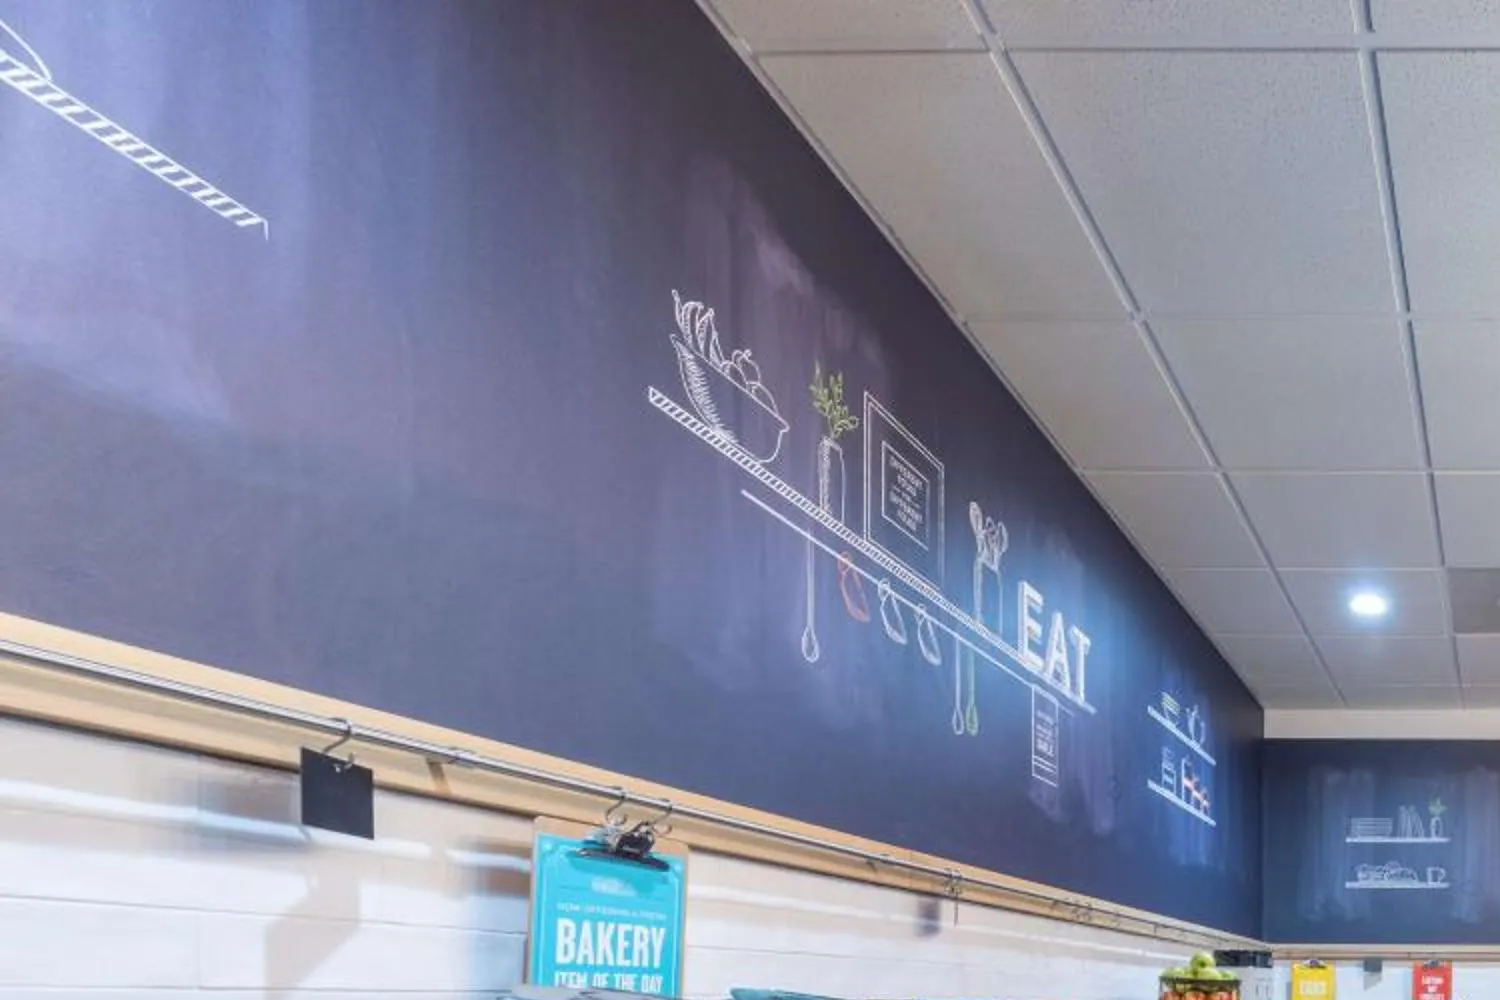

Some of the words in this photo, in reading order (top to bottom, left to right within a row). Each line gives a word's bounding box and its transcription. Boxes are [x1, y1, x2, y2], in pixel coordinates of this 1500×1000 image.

[1018, 581, 1091, 703] EAT
[555, 917, 666, 969] BAKERY
[592, 972, 608, 987] OF
[614, 973, 638, 991] THE
[640, 974, 663, 993] DAY
